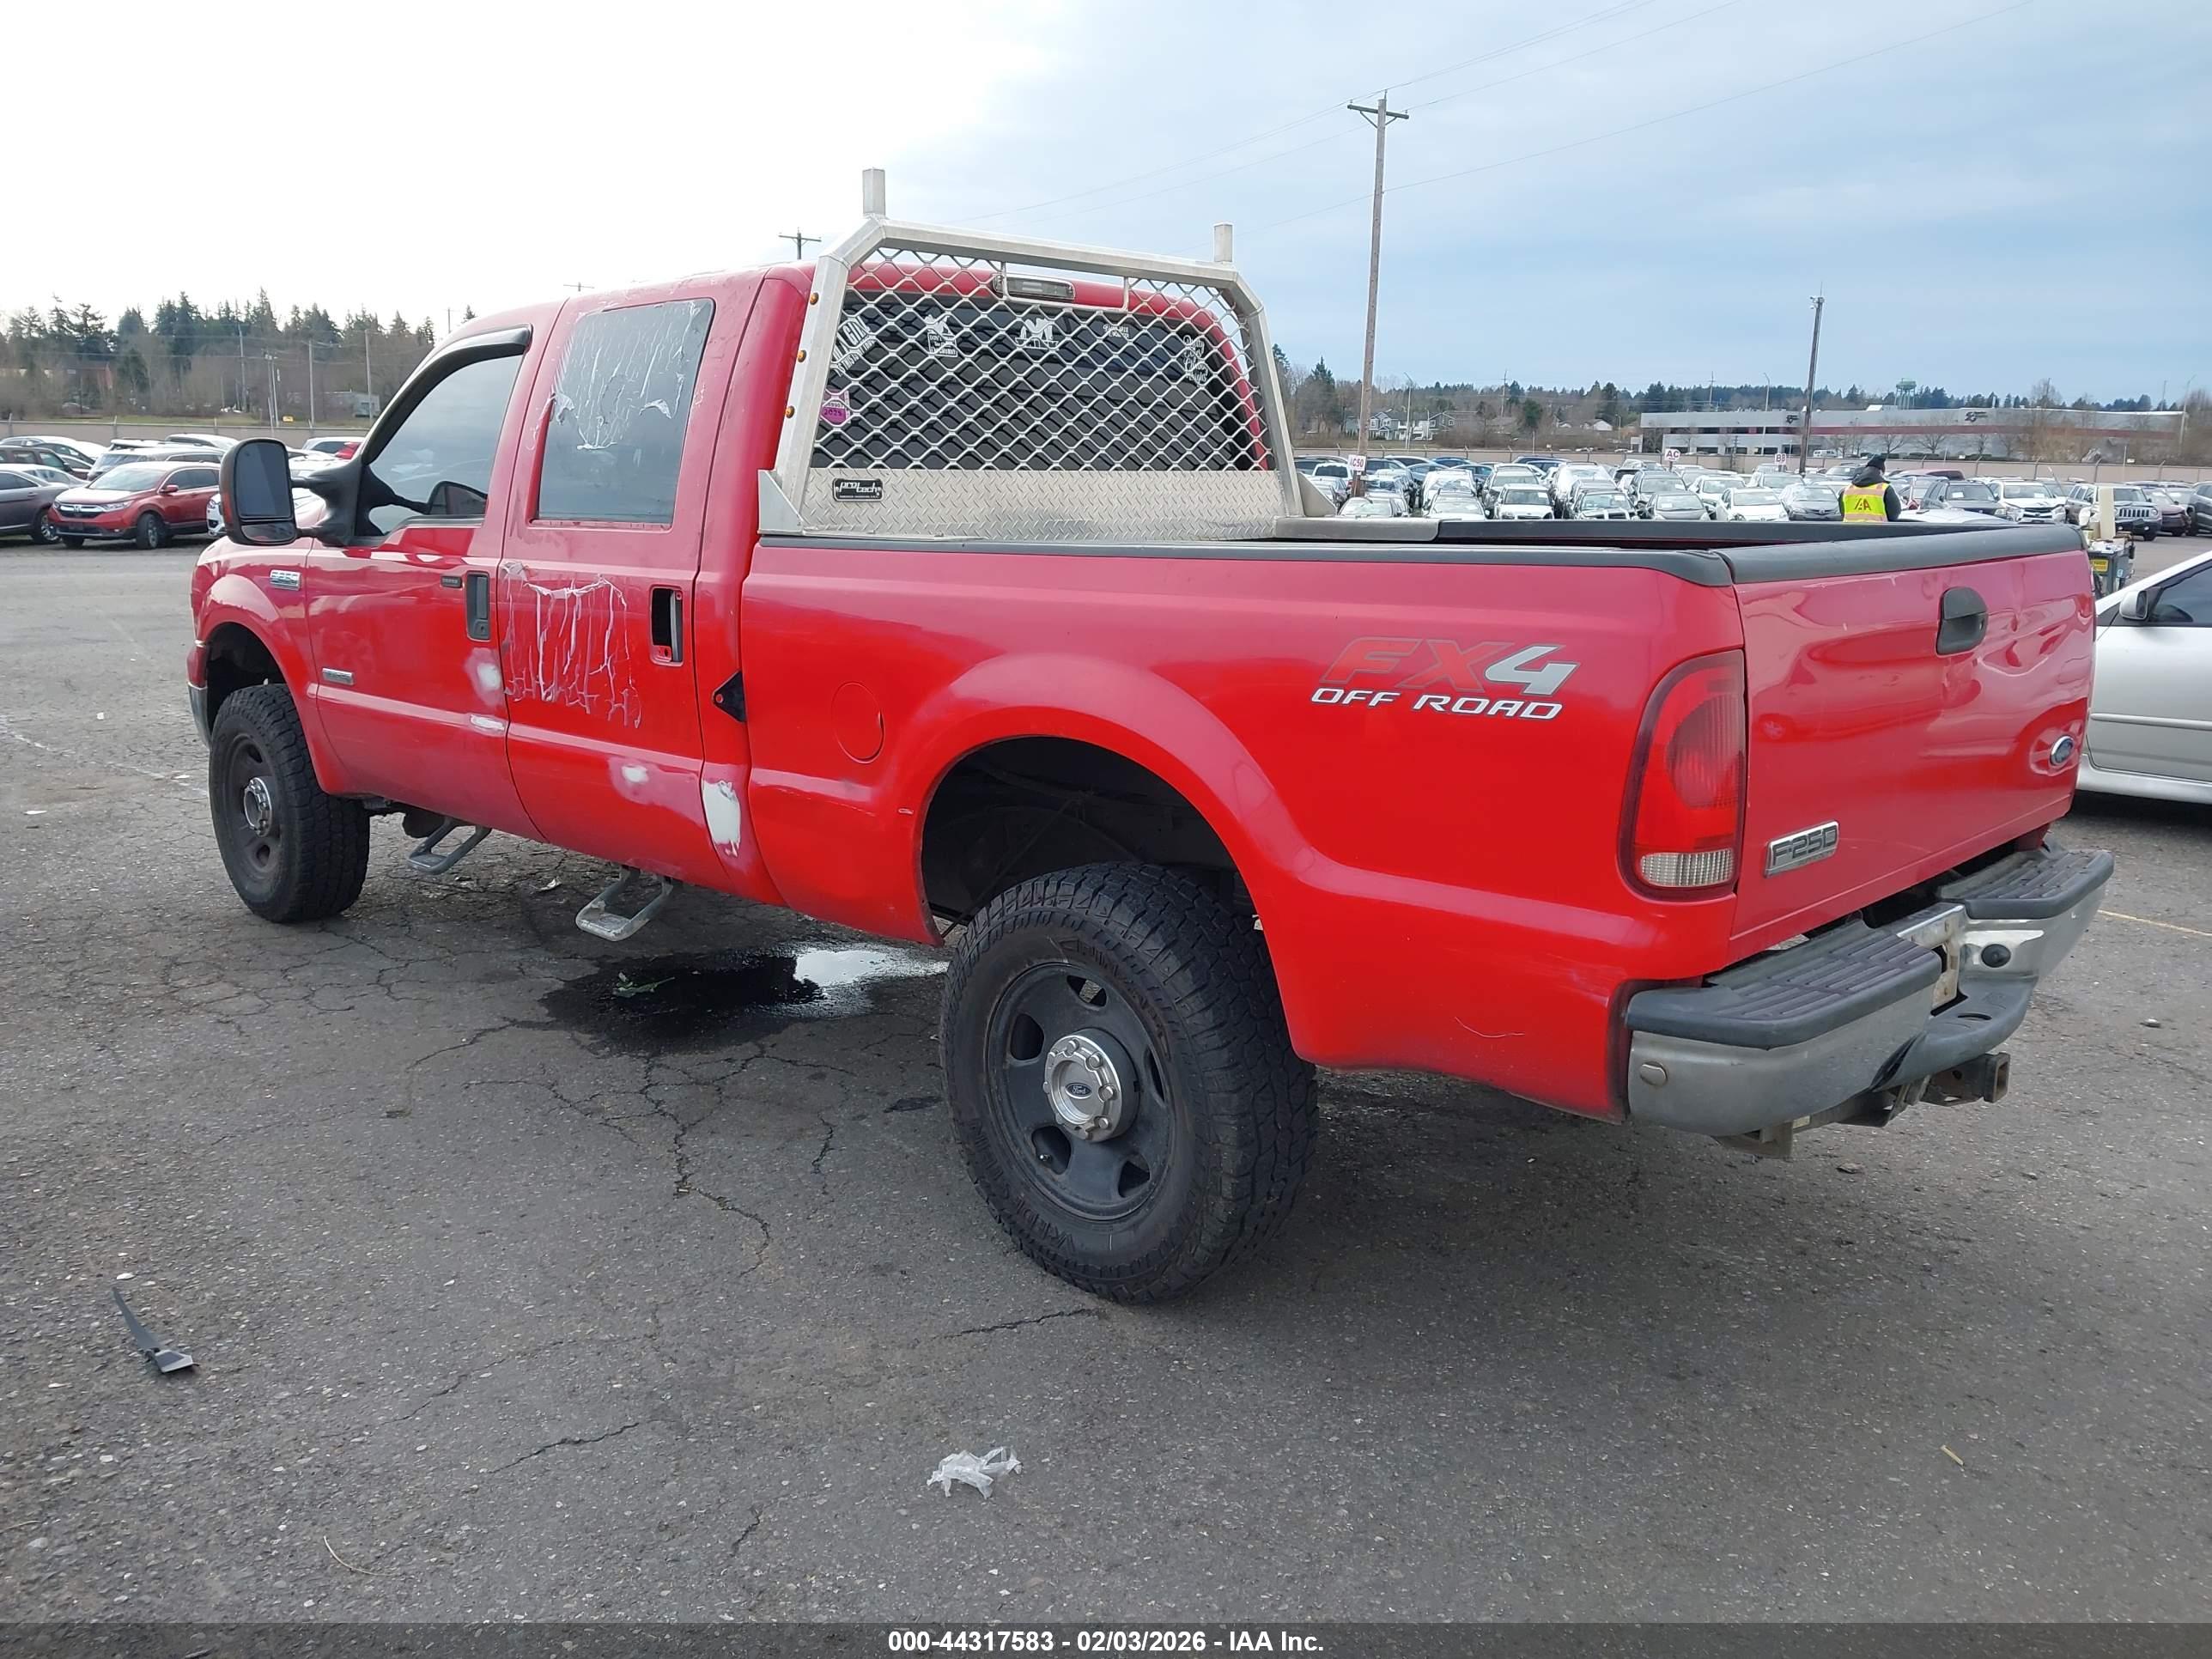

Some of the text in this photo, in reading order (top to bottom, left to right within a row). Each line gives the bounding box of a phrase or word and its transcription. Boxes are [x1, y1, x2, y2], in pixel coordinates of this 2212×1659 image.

[1318, 636, 1582, 696] FX4
[1310, 688, 1564, 720] OFF ROAD
